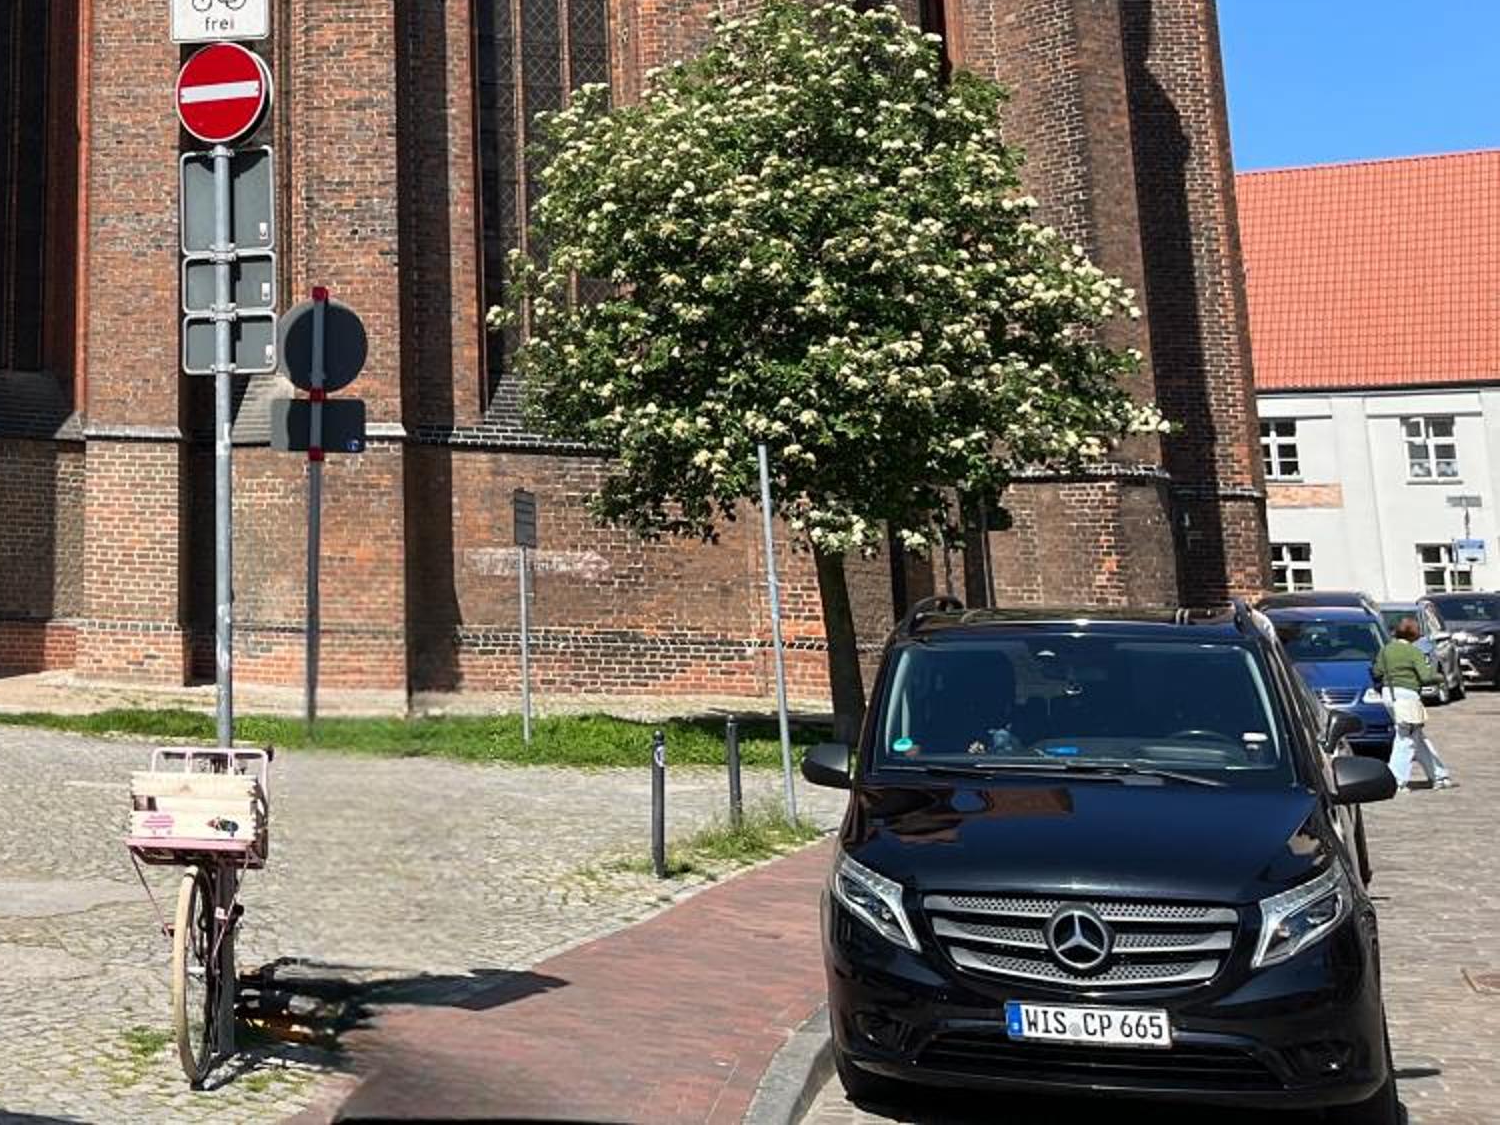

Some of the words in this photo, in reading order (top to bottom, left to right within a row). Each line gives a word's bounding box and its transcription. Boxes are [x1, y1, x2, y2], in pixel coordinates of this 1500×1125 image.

[205, 16, 235, 32] frei
[1025, 1008, 1067, 1034] WIS
[1083, 1012, 1112, 1037] CP
[1120, 1014, 1164, 1040] 665
